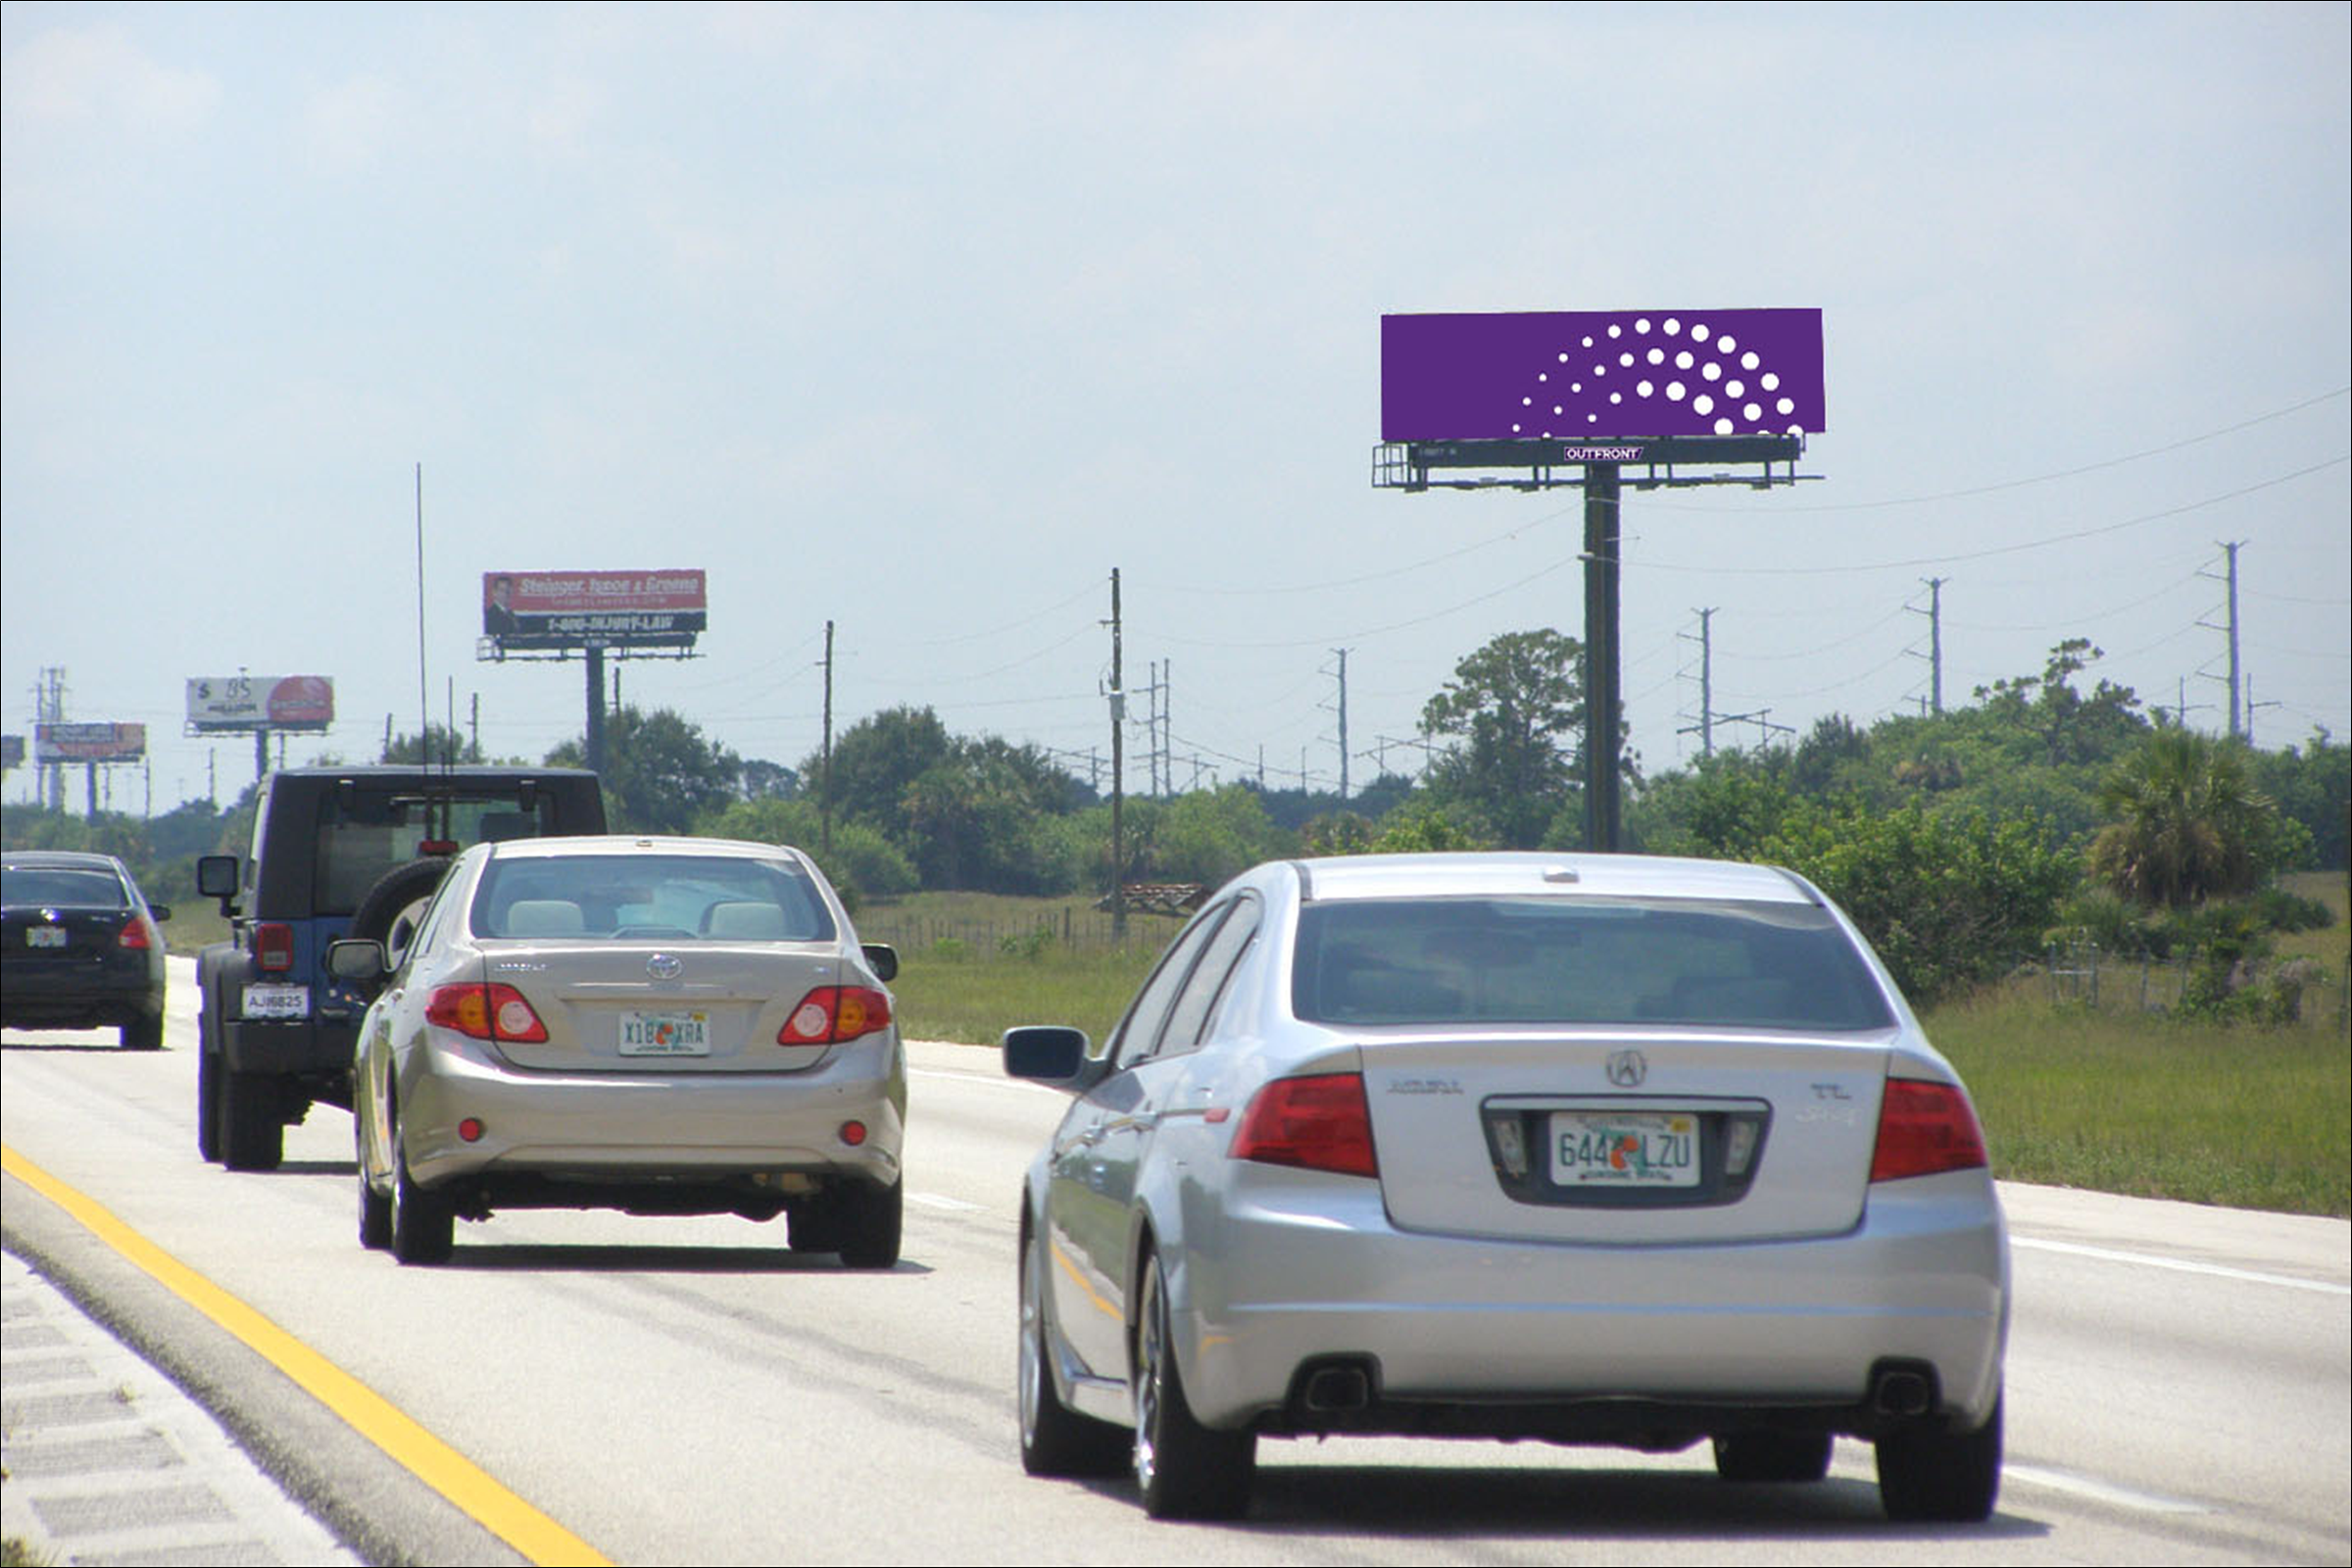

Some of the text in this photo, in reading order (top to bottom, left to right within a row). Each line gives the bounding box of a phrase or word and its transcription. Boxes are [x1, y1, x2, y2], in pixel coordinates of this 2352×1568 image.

[1567, 448, 1638, 460] OUTFRONT
[1560, 1134, 1691, 1168] 644 LZU
